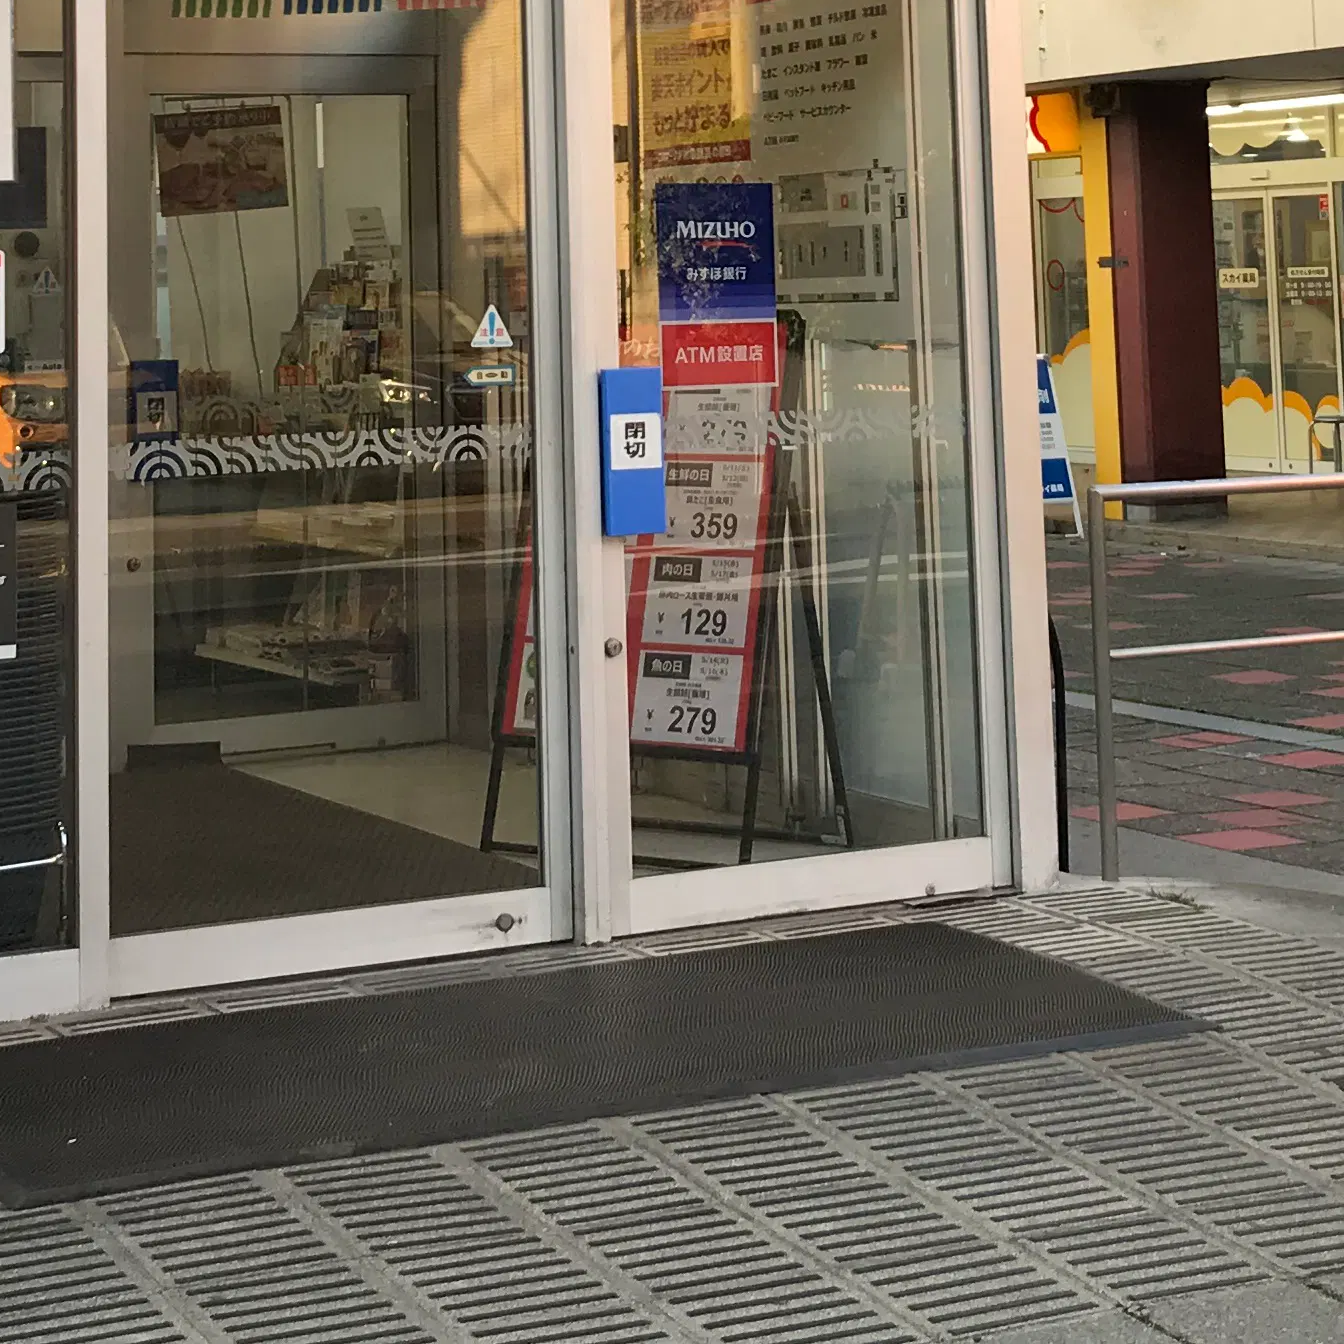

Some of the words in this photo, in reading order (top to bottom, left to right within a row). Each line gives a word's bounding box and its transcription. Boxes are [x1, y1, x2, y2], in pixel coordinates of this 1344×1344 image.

[676, 220, 756, 239] MIZUHO
[686, 267, 747, 282] みずほ銀行
[480, 327, 504, 337] 注意
[675, 344, 764, 364] ATM設置店
[624, 421, 646, 458] 閉切
[668, 467, 710, 481] 生鮮の日
[690, 512, 738, 539] 359
[661, 563, 694, 576] 肉の日
[681, 608, 727, 637] 129
[651, 658, 683, 673] 魚の日
[667, 705, 717, 735] 279
